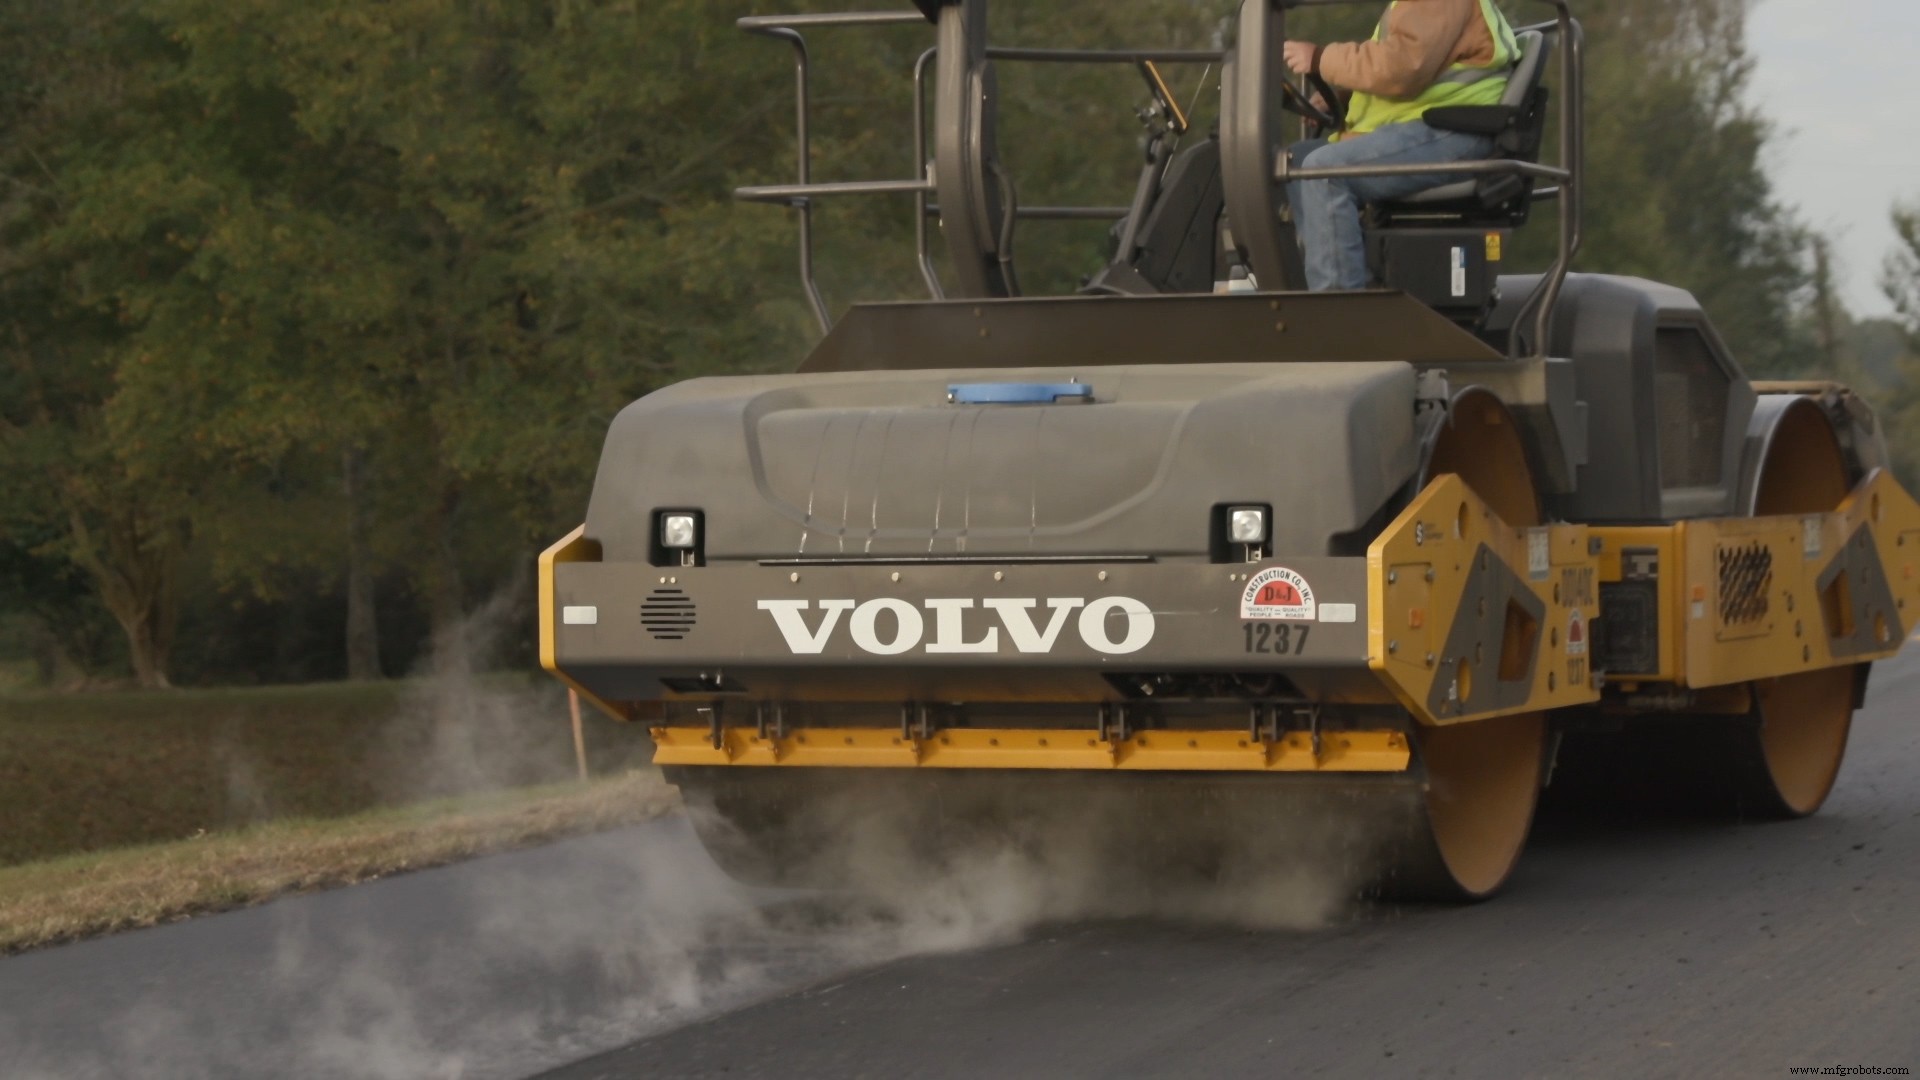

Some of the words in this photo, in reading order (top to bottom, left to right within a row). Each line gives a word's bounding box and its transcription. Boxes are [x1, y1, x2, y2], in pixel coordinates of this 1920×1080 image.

[1245, 570, 1291, 602] CONSTRUCTION
[757, 596, 1156, 655] VOLVO
[1243, 622, 1310, 655] 1237
